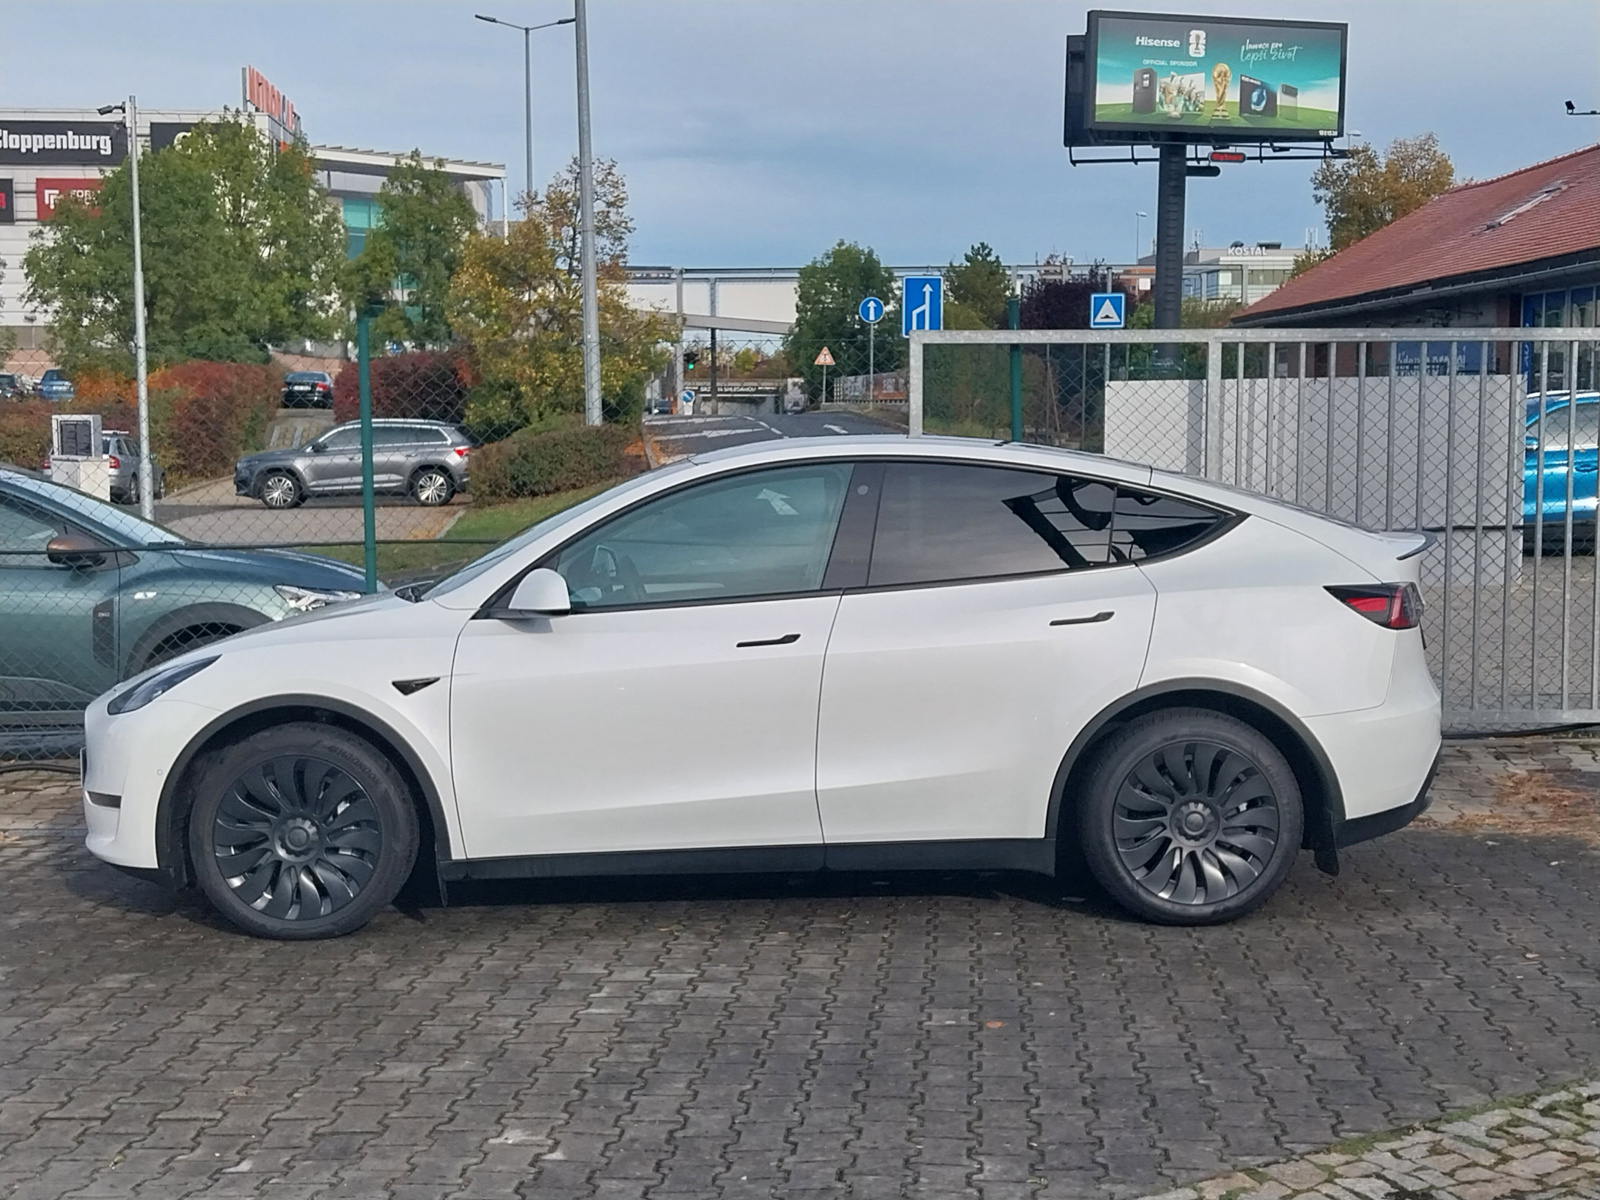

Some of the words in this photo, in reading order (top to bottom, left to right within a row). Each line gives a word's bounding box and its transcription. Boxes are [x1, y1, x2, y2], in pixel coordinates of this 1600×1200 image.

[1135, 36, 1181, 48] Hisense
[0, 129, 112, 155] loppenburg
[1227, 246, 1268, 256] KOSTAL
